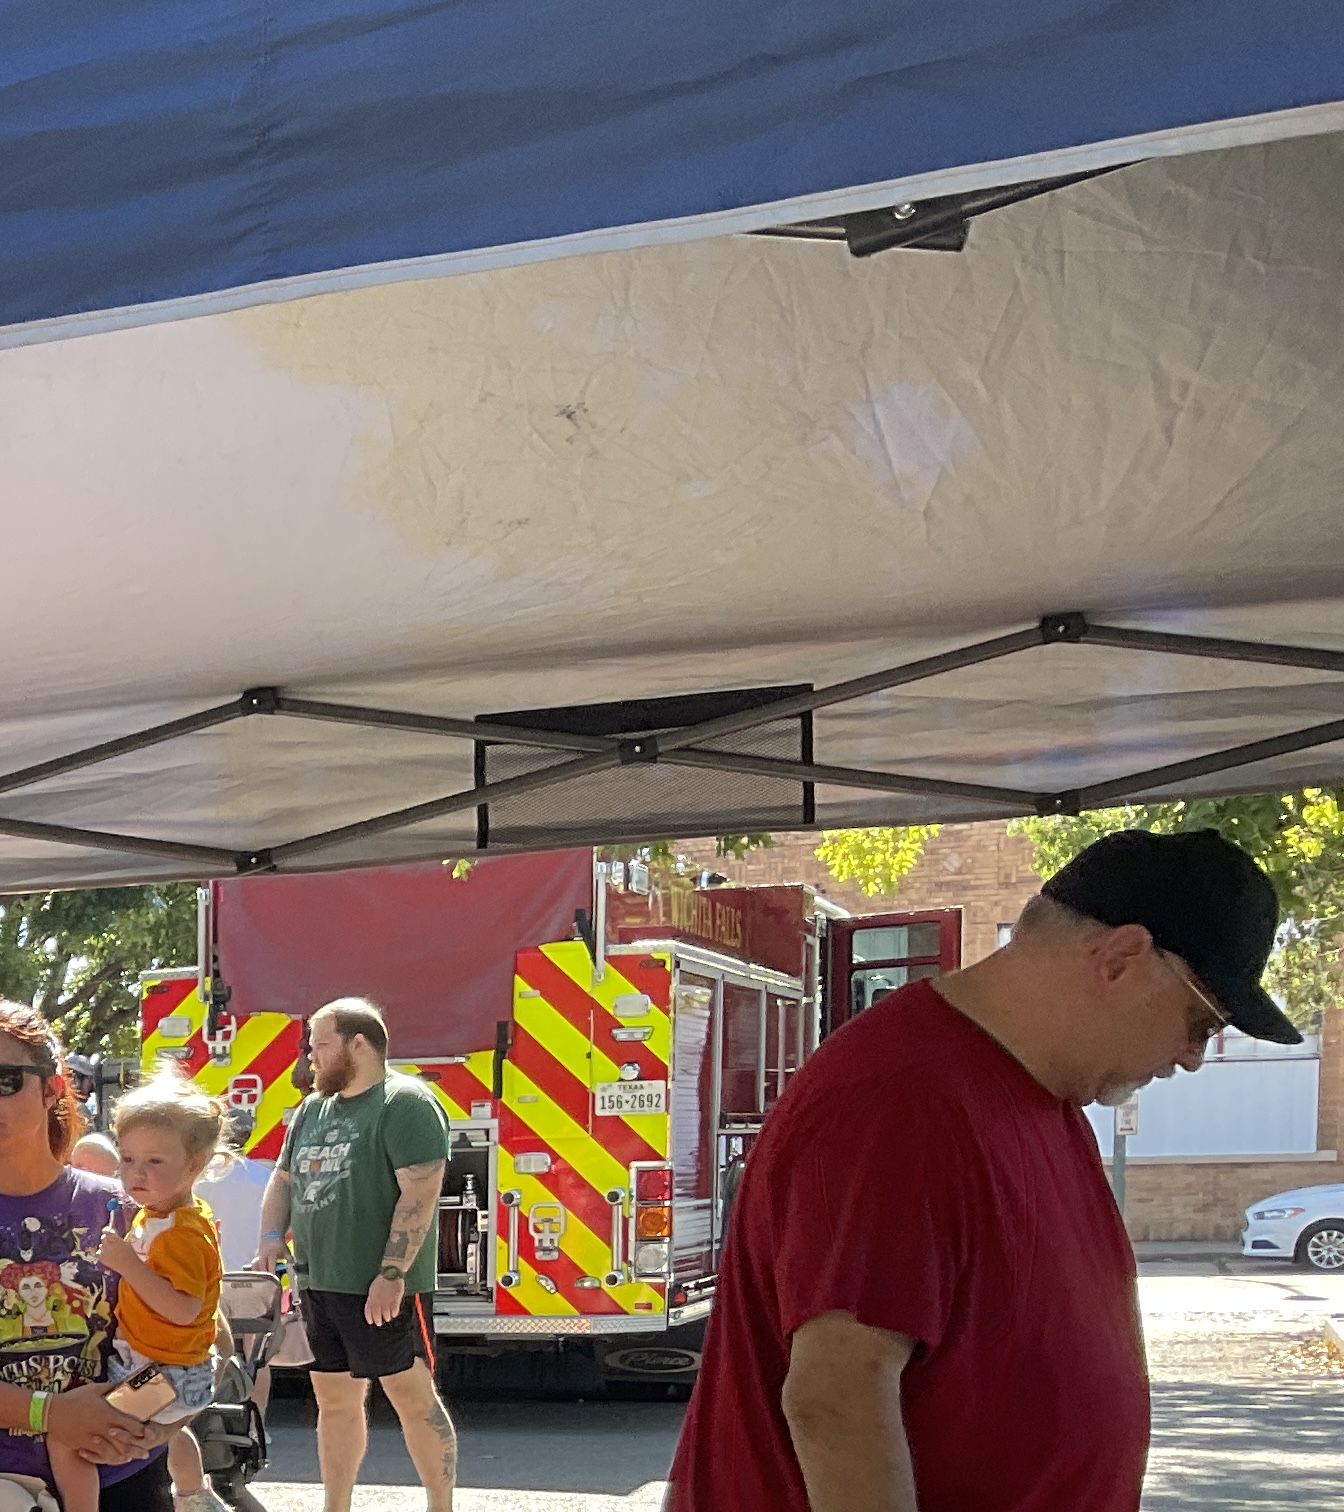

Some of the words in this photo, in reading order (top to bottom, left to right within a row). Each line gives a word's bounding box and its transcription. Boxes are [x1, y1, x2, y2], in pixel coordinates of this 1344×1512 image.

[716, 901, 742, 949] FALLS
[296, 1143, 351, 1160] PEACH
[299, 1159, 340, 1173] BOWL
